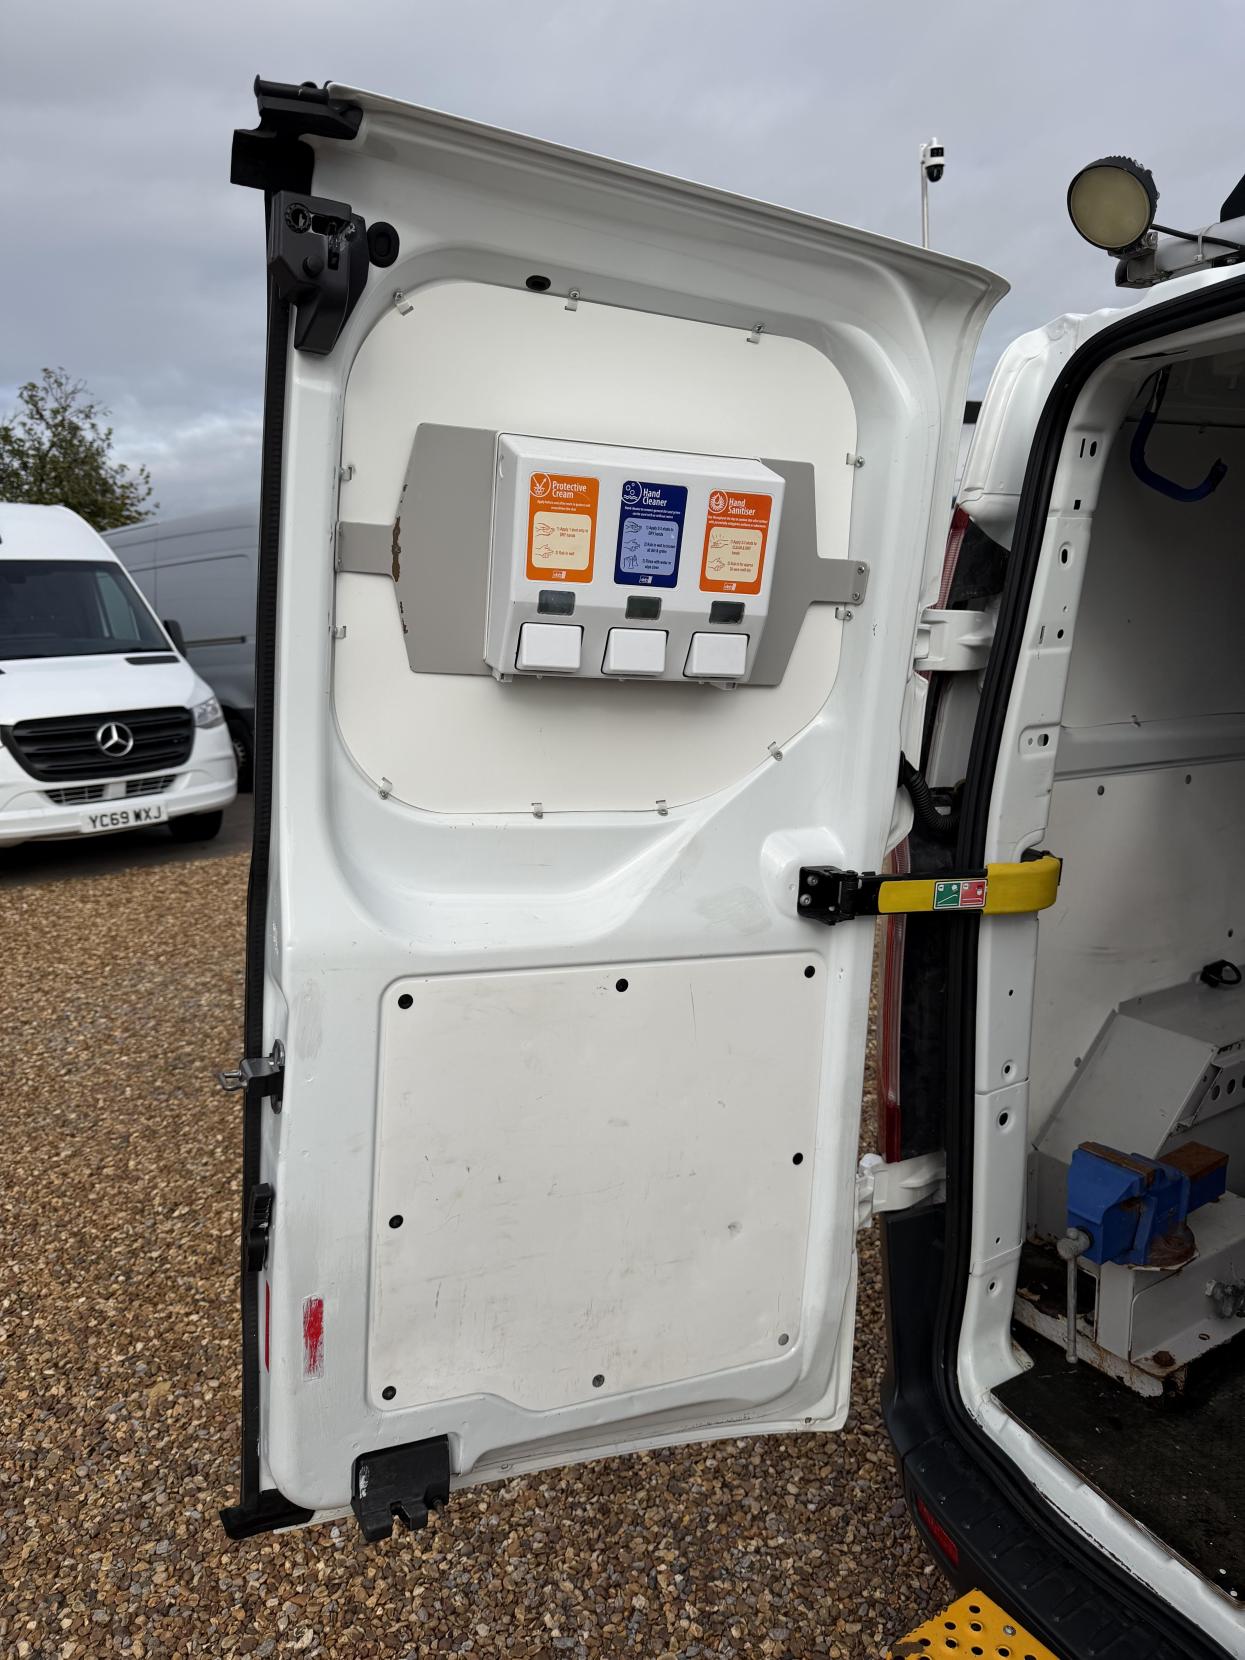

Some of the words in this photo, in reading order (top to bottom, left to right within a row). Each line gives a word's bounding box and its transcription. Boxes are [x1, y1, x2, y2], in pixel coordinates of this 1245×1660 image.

[552, 481, 587, 492] Protective
[552, 490, 574, 499] Cream
[643, 489, 661, 498] Hand
[643, 497, 667, 506] Cleaner
[729, 498, 746, 507] Hand
[728, 506, 756, 516] Sanitiser
[89, 811, 130, 829] YC69
[133, 806, 162, 823] WXJ
